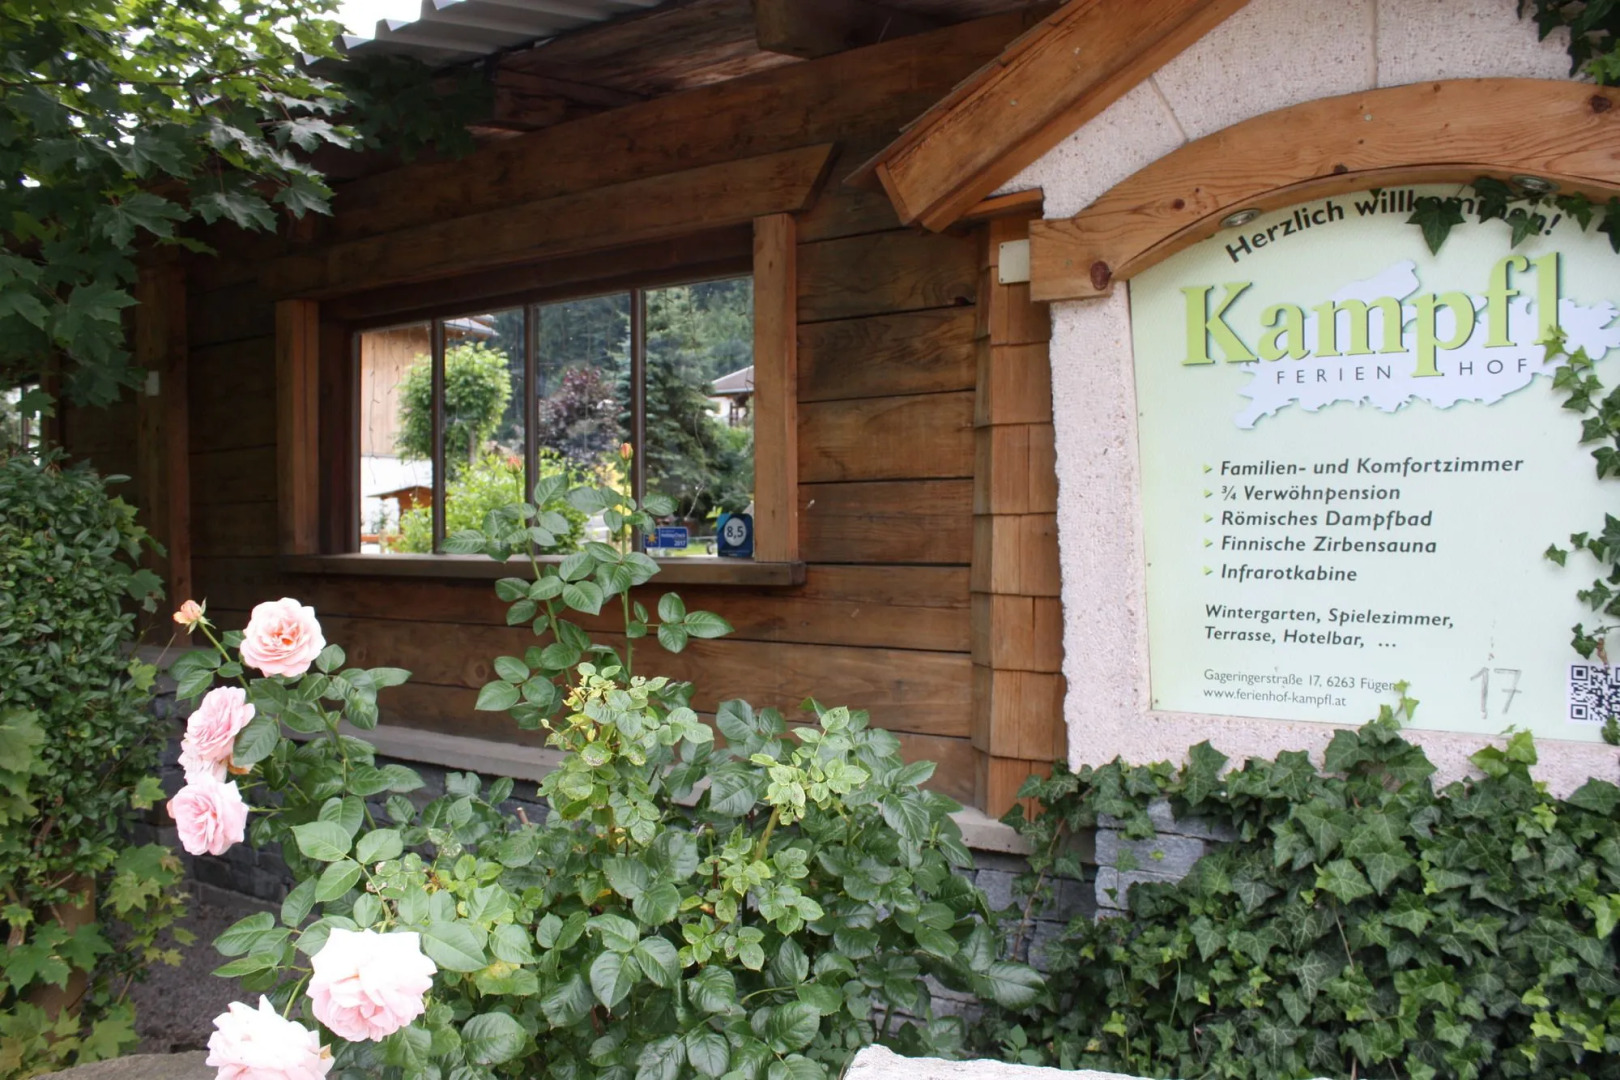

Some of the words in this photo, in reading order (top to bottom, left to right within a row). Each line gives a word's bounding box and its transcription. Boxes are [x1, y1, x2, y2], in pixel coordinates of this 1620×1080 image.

[1225, 200, 1345, 263] Herzlich
[1355, 189, 1562, 236] willkmn!
[1181, 252, 1563, 377] Kampfl
[1276, 364, 1391, 385] FERIEN
[1459, 357, 1528, 376] HOF
[1220, 459, 1307, 476] Familien-
[1313, 457, 1350, 475] und
[1356, 456, 1524, 478] Komfortzimmer
[1244, 484, 1401, 505] Verwöhnpension
[1221, 509, 1318, 527] Römisches
[1325, 510, 1433, 532] Dampfbad
[726, 526, 744, 539] 8,5
[1221, 535, 1306, 552] Finnische
[1312, 535, 1437, 554] Zirbensauna
[1221, 563, 1358, 584] Infrarotkabine
[1205, 603, 1322, 625] Wintergarten,
[1328, 606, 1455, 630] Spielezimmer,
[1204, 625, 1276, 645] Terrasse,
[1283, 628, 1365, 649] Hotelbar,
[1203, 668, 1303, 686] Gageringerstraße
[1326, 675, 1356, 689] 6263
[1360, 677, 1397, 694] Fügen
[1470, 666, 1523, 719] 17
[1203, 688, 1347, 708] www.ferienhof-kampfl.at
